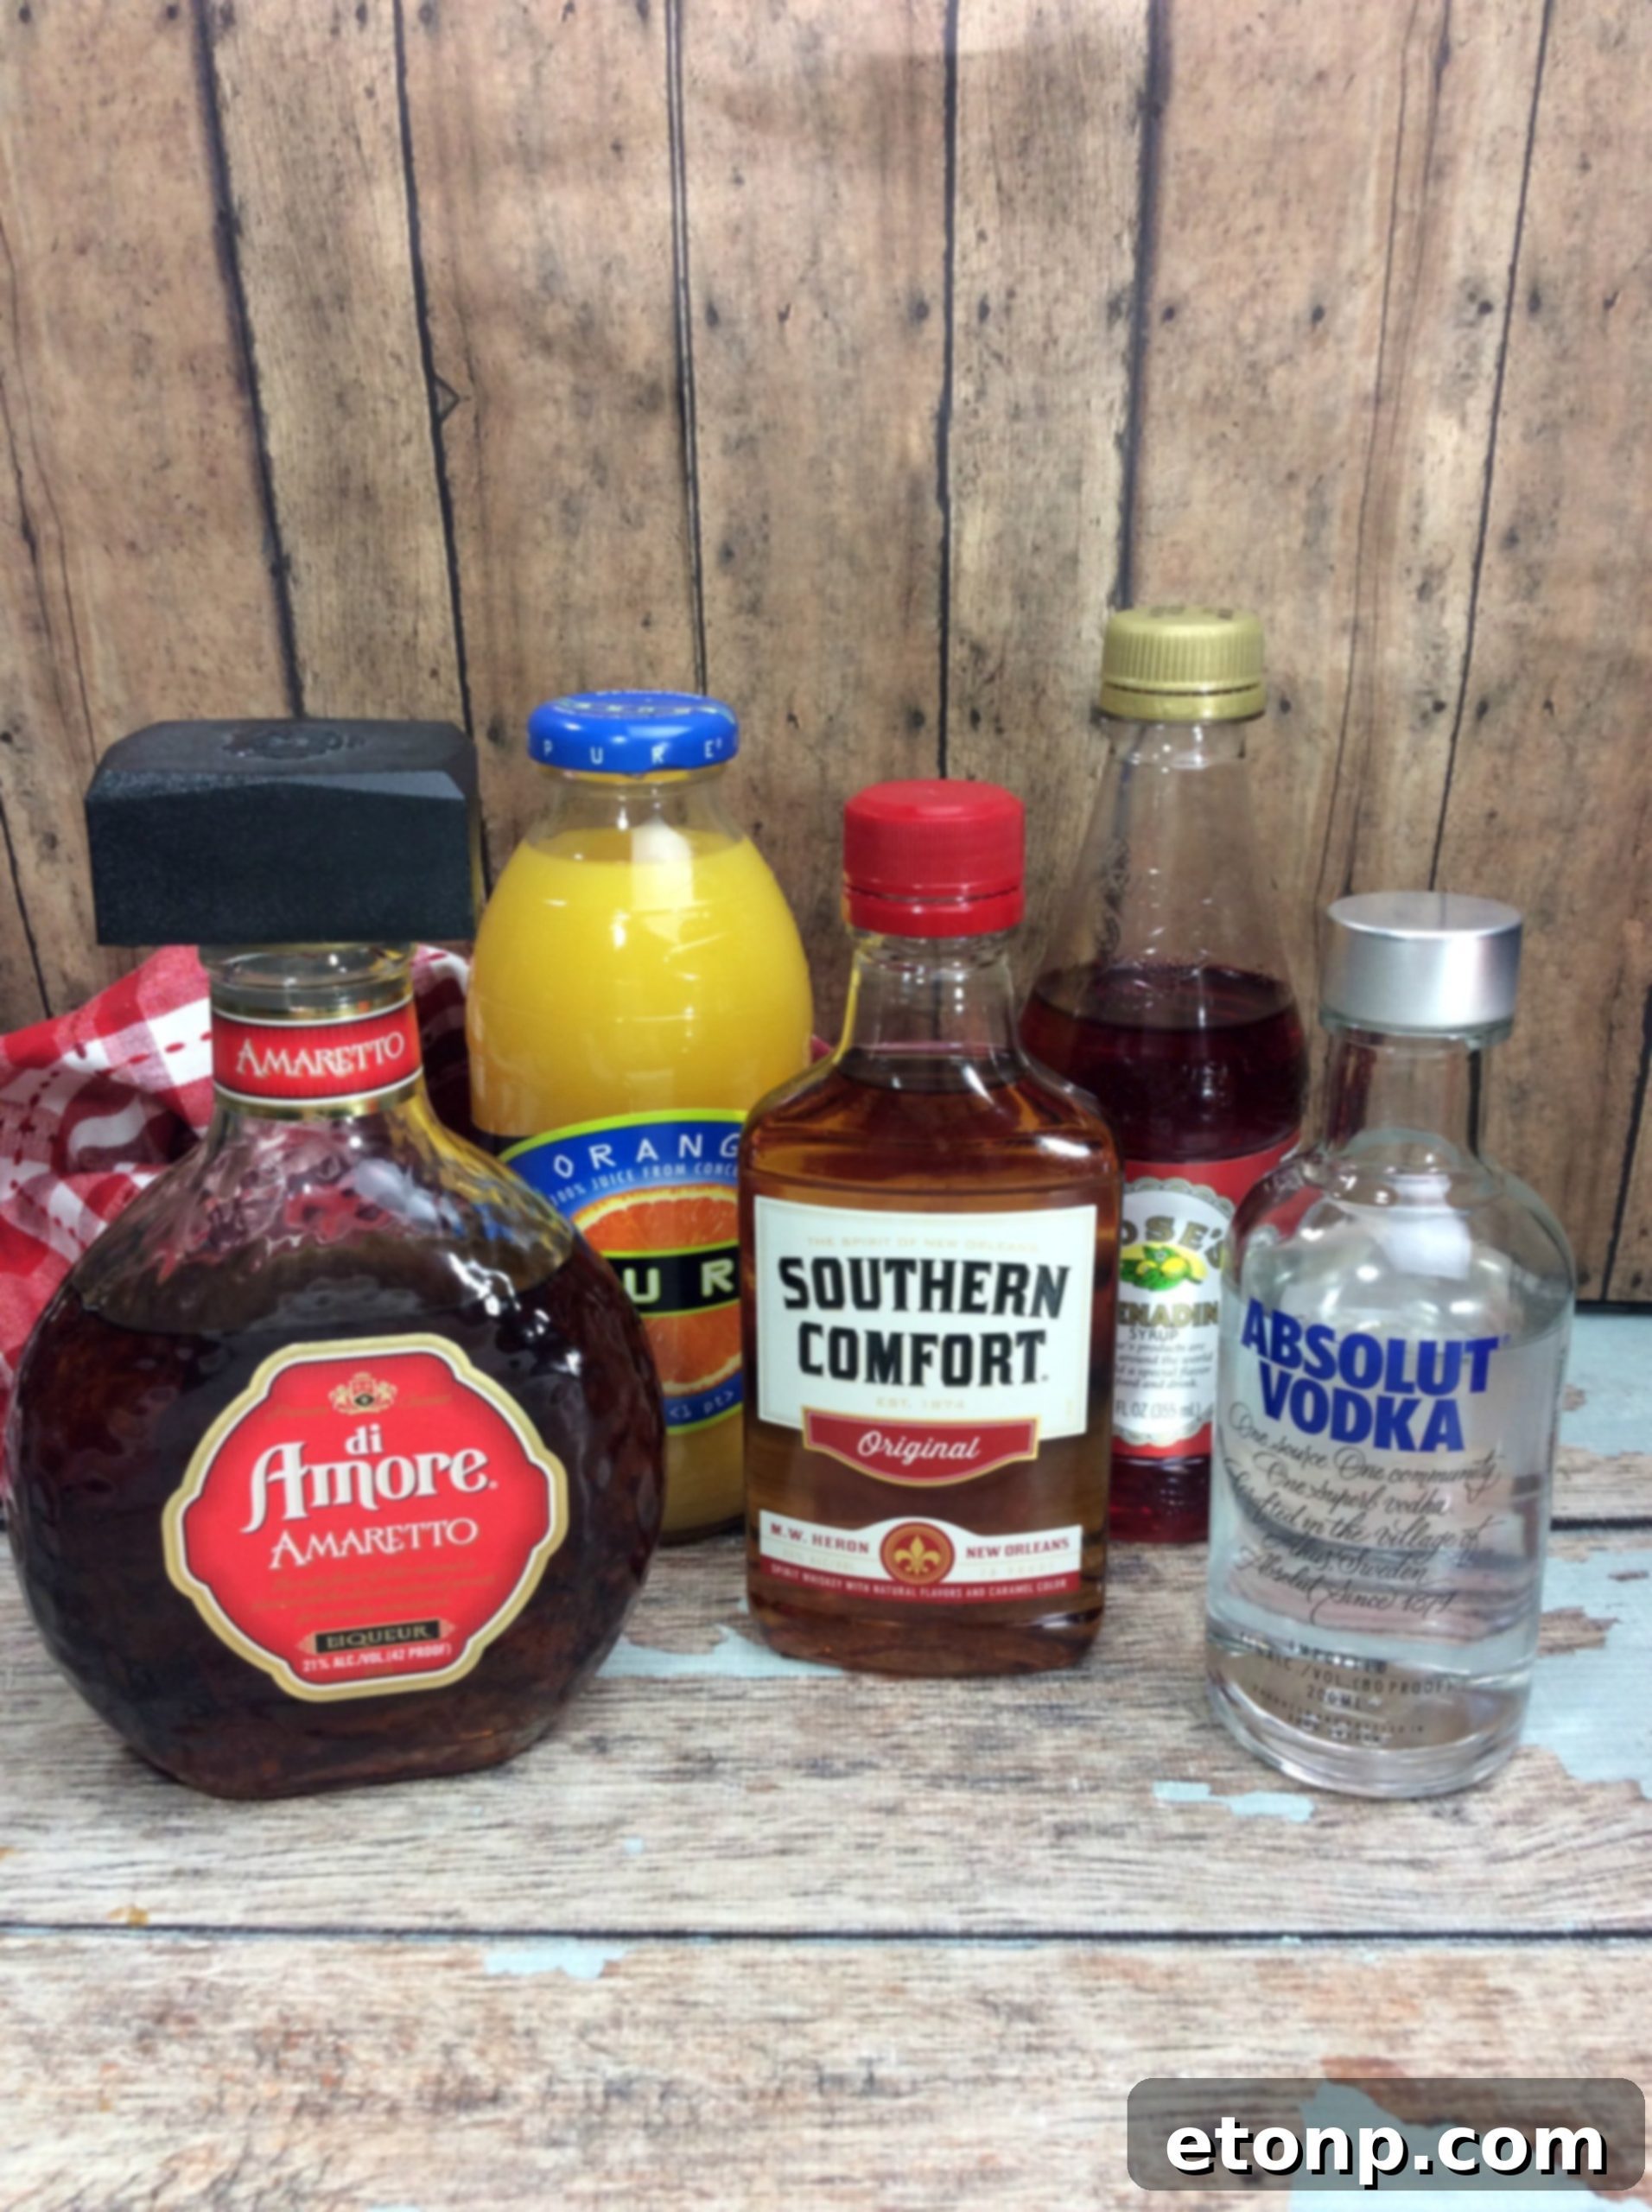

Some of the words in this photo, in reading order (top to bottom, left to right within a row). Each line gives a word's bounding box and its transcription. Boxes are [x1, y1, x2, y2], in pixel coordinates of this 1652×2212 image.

[235, 1031, 406, 1078] AMARETTO
[553, 1133, 740, 1179] ORANG
[591, 1169, 635, 1192] JUICE
[642, 1163, 687, 1179] FROM
[694, 1162, 739, 1178] CONC
[1121, 1216, 1223, 1269] OSE'
[623, 1258, 734, 1303] UR
[778, 1256, 1071, 1319] SOUTHERN
[1118, 1301, 1220, 1327] ENADIN
[1129, 1325, 1179, 1340] SYRUP
[797, 1321, 1047, 1388] COMFORT
[1241, 1297, 1500, 1396] ABSOLUT
[1259, 1358, 1465, 1452] VODKA
[345, 1422, 383, 1455] di
[857, 1430, 981, 1466] Original
[268, 1516, 480, 1570] AMARETTO
[811, 1533, 870, 1554] HERON
[965, 1545, 1001, 1560] NEW
[1004, 1536, 1070, 1557] ORLEANS
[873, 1584, 916, 1598] NATURAL
[918, 1586, 963, 1599] FLAVORS
[965, 1587, 986, 1598] AND
[988, 1583, 1034, 1598] CARAMEL
[1037, 1578, 1067, 1592] COLOR
[326, 1624, 429, 1649] LIQUEUR
